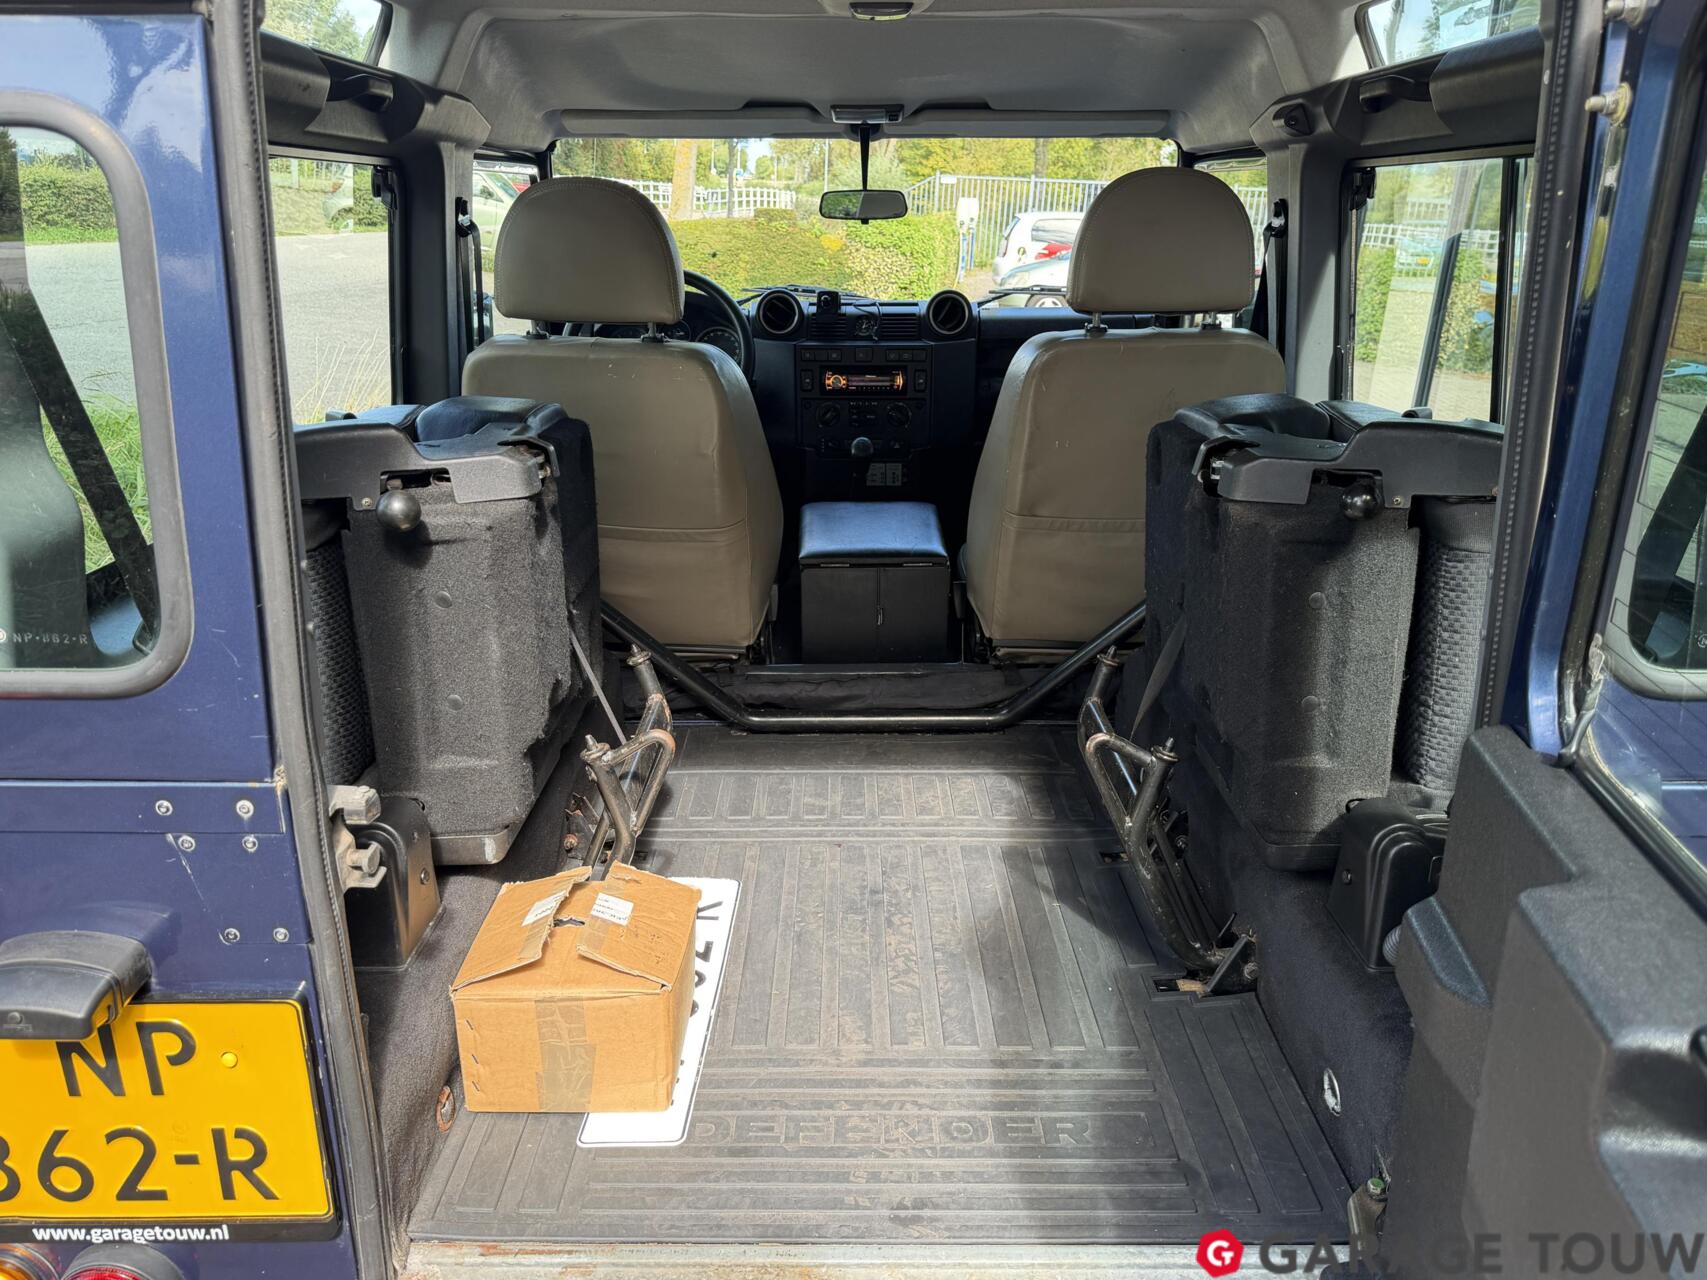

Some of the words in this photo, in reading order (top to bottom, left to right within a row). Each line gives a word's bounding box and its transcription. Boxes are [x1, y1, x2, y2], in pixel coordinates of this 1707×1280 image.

[55, 1020, 197, 1097] NP
[693, 1113, 1093, 1145] DEFENDER
[32, 1225, 230, 1244] www.garagetouw.nl
